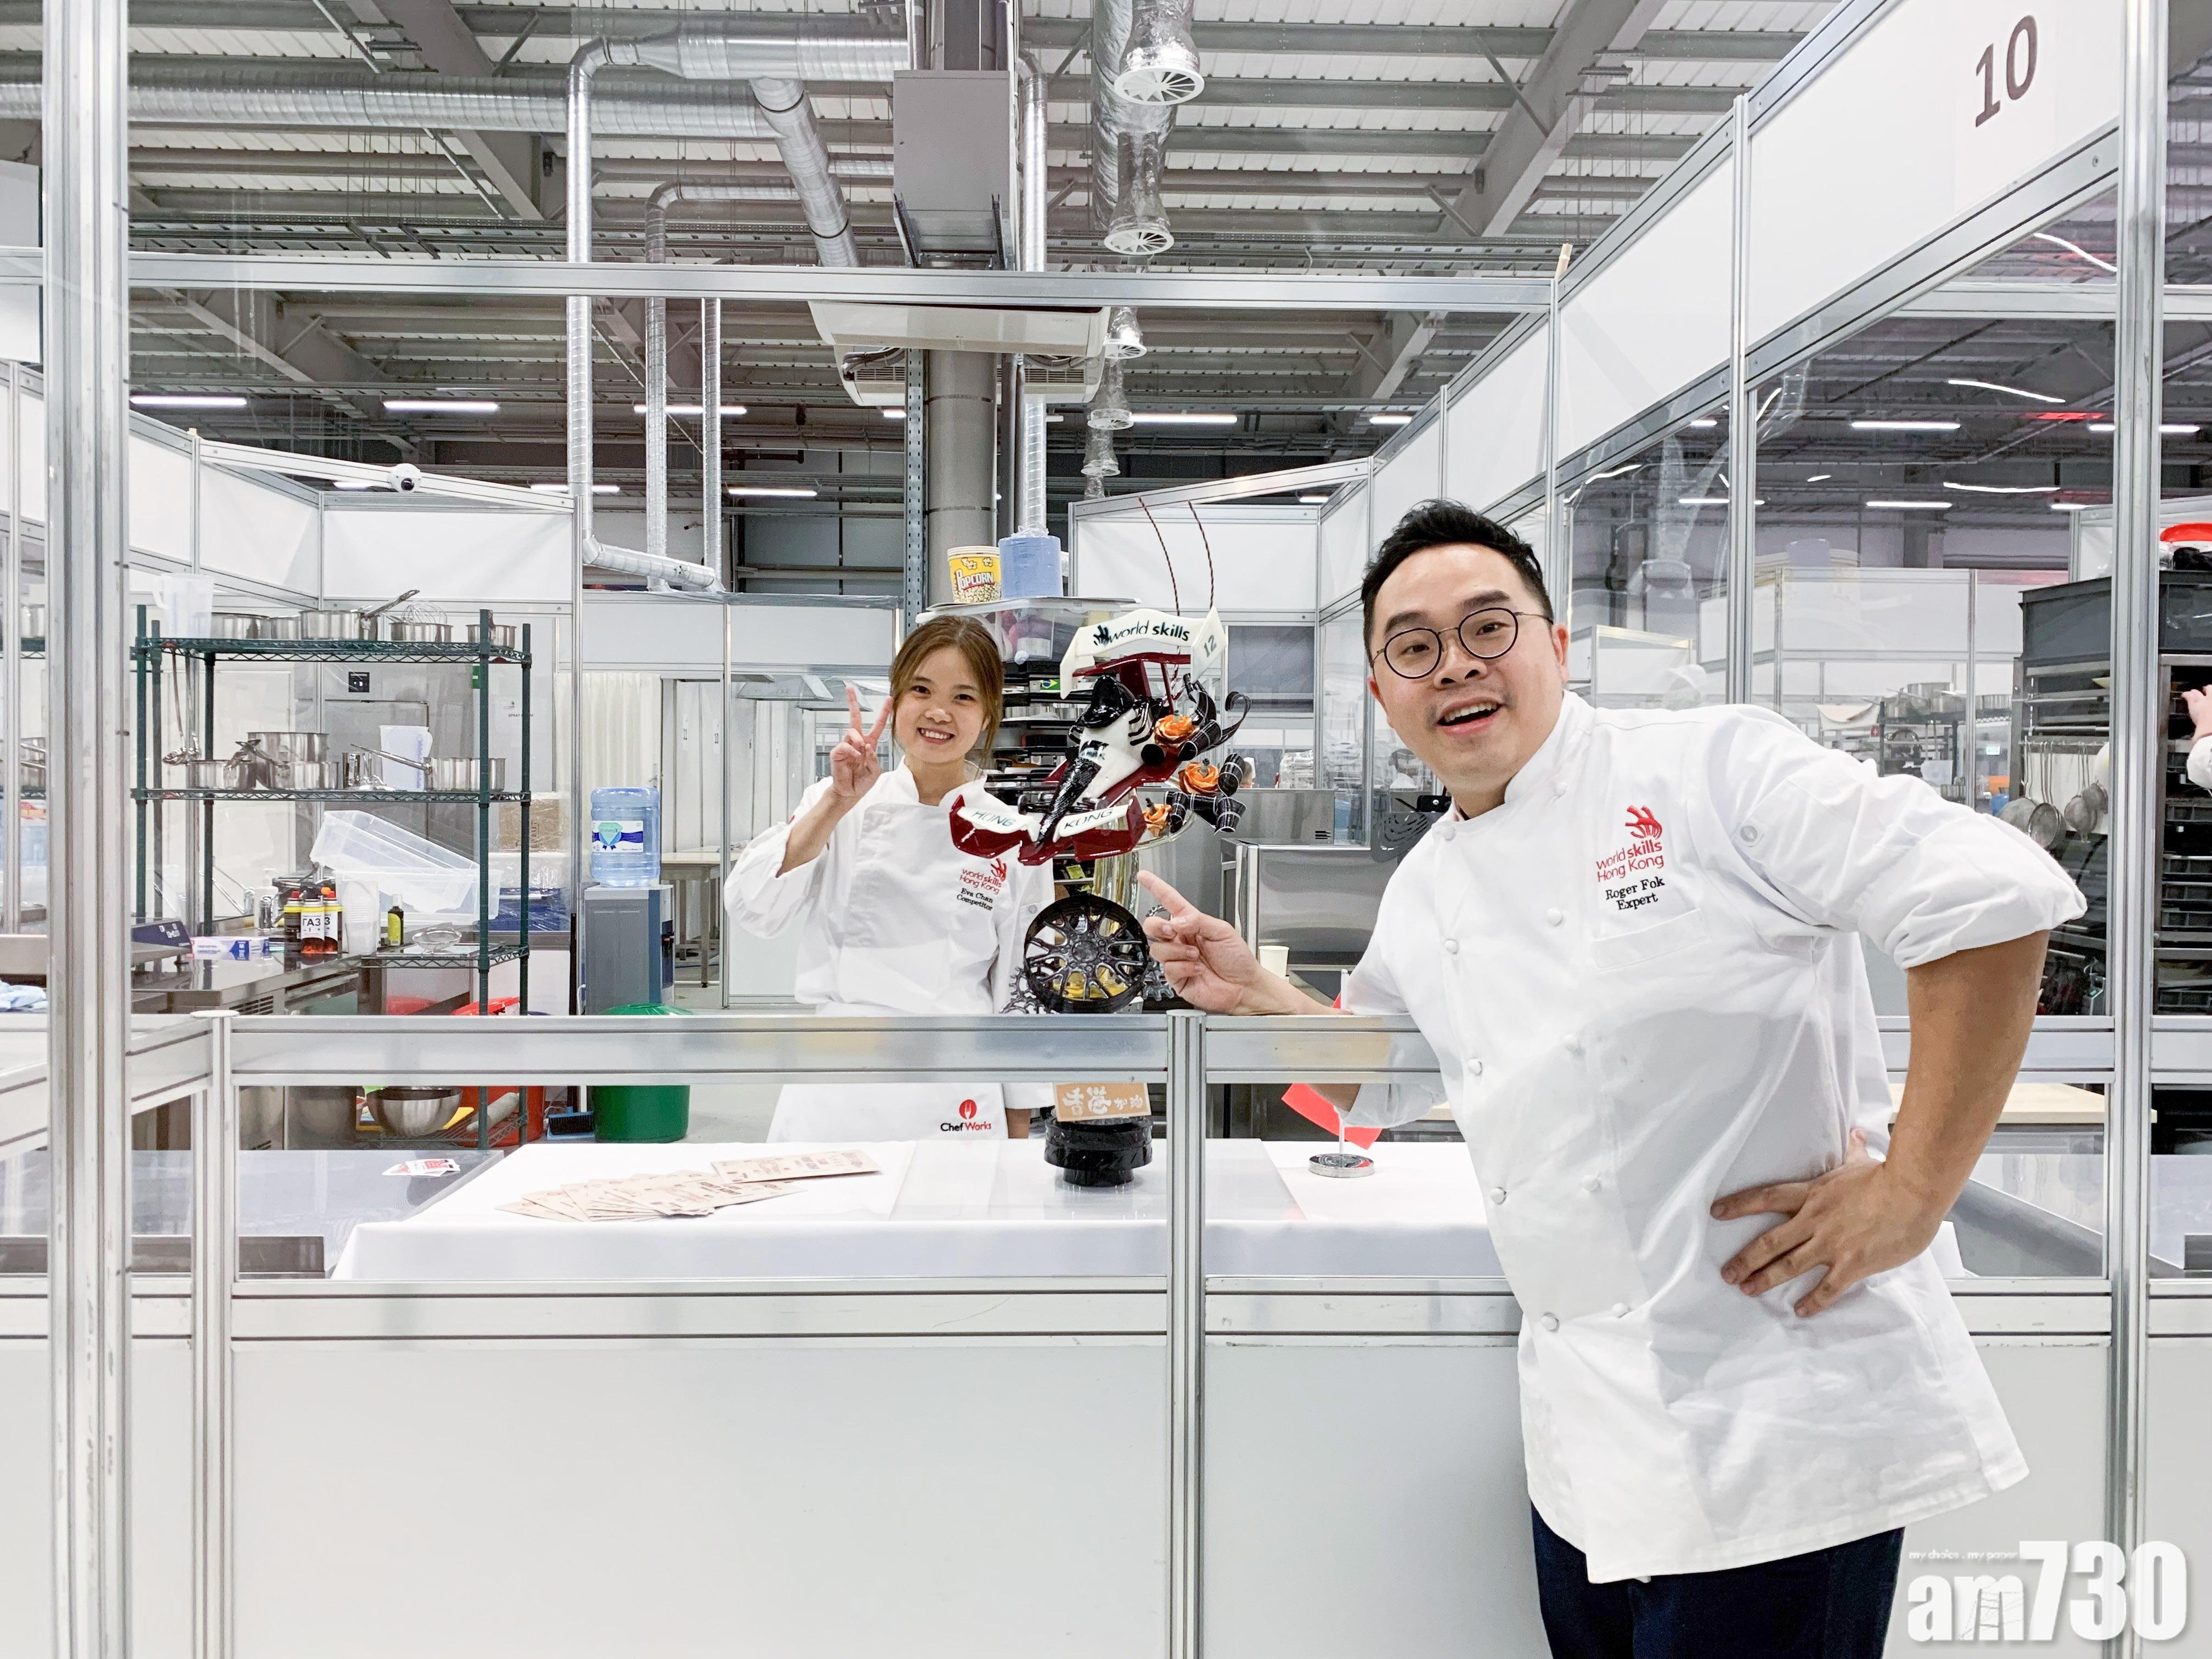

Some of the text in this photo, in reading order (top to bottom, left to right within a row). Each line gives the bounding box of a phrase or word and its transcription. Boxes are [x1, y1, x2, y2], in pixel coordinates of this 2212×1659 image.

[1976, 15, 2038, 127] 10
[955, 568, 995, 594] POPCORN
[1110, 620, 1190, 643] world skills
[1204, 634, 1217, 658] 12
[972, 811, 1016, 826] HONG
[1064, 808, 1114, 830] KONG
[1596, 839, 1662, 870] world skills
[962, 869, 1002, 888] world skills
[1597, 855, 1664, 882] Hong Kong
[960, 874, 1000, 895] Hong Kong
[1605, 876, 1665, 900] Roger Fok
[957, 894, 993, 911] Competitor
[961, 888, 994, 904] Eva Chan
[1616, 892, 1658, 910] Expert
[302, 918, 321, 927] ГАЗ
[940, 1121, 991, 1132] Chef Works
